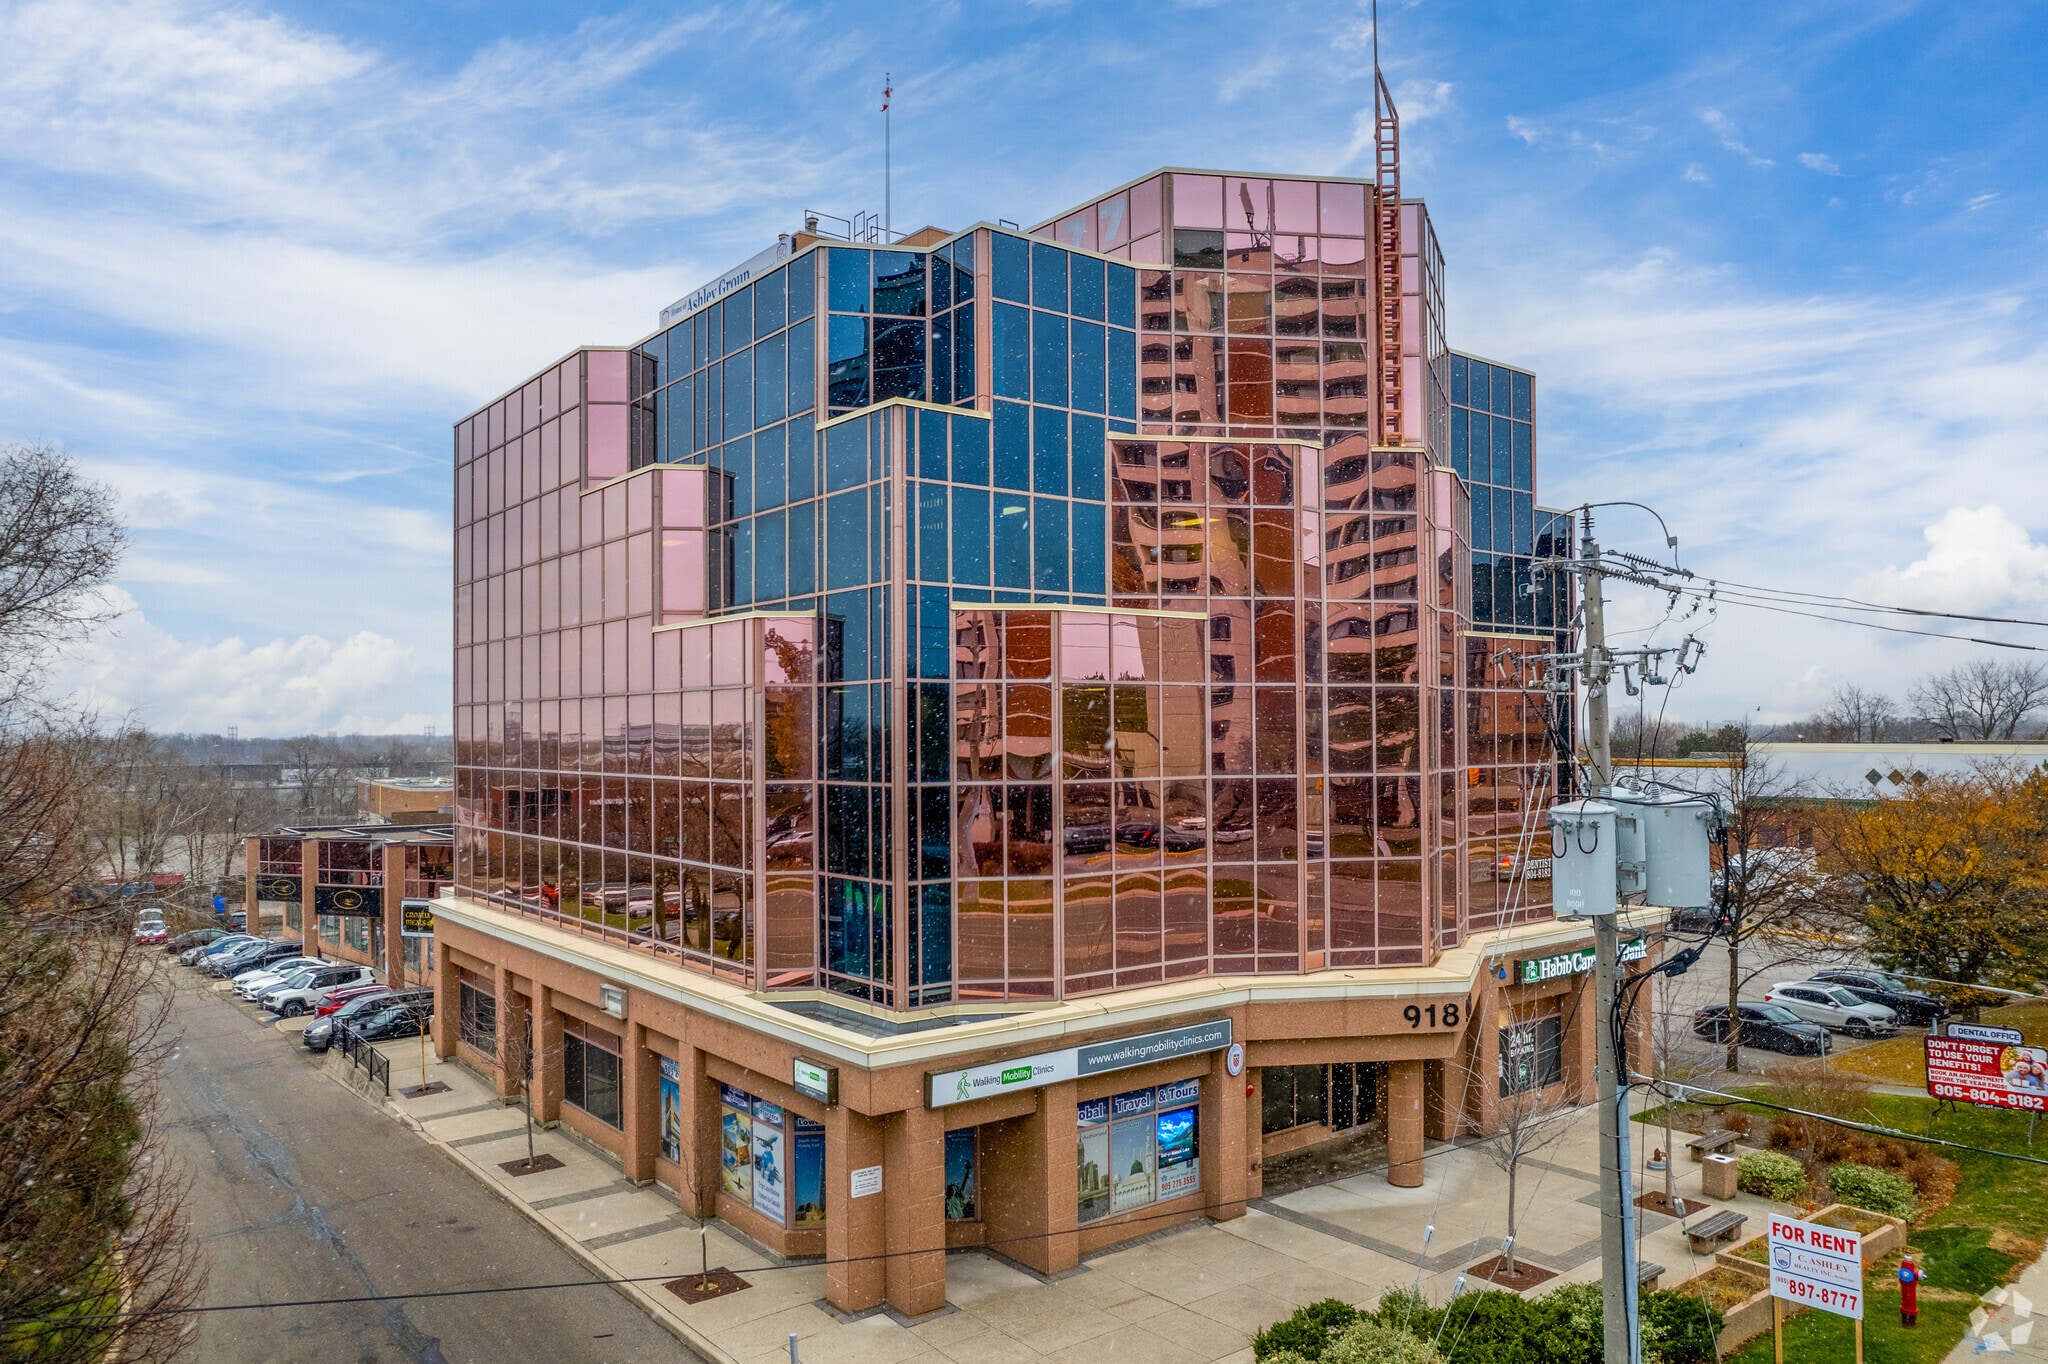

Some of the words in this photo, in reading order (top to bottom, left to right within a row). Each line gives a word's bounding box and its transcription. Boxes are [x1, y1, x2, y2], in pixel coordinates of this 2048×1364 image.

[1526, 858, 1551, 869] DENTIST
[1538, 954, 1572, 979] Habib
[1618, 939, 1648, 962] Bank
[1403, 1003, 1460, 1028] 918
[1510, 1033, 1521, 1048] 24
[1957, 1027, 1989, 1038] DENTAL
[1990, 1030, 2020, 1041] OFFICE
[1088, 1030, 1222, 1066] www.walkingmobilityclinics.com
[1928, 1039, 1958, 1050] DON'T
[1959, 1043, 2000, 1055] FORGET
[1928, 1049, 1942, 1057] TO
[1943, 1051, 1965, 1060] USE
[1965, 1053, 1993, 1064] YOUR
[1929, 1058, 1981, 1071] BENEFITS!
[972, 1074, 1001, 1088] Walking
[1002, 1067, 1031, 1084] Mobility
[1032, 1064, 1055, 1077] Clinics
[1930, 1075, 1955, 1083] BEFORE
[1988, 1082, 2008, 1090] ENDS!
[1959, 1073, 2004, 1084] APPOINTMENT
[1115, 1093, 1151, 1113] Travel
[1158, 1090, 1168, 1103] &
[1168, 1085, 1199, 1100] Tours
[1934, 1083, 2044, 1110] 905-804-8182
[1161, 1182, 1171, 1192] 905
[1172, 1178, 1182, 1188] 275
[1183, 1174, 1196, 1186] 3555
[1772, 1221, 1805, 1244] FOR
[1811, 1231, 1857, 1255] RENT
[1794, 1263, 1819, 1274] REALTY
[1797, 1254, 1808, 1263] C.
[1809, 1258, 1849, 1274] ASHLEY
[1775, 1275, 1789, 1285] (905)
[1789, 1280, 1857, 1311] 897-8777
